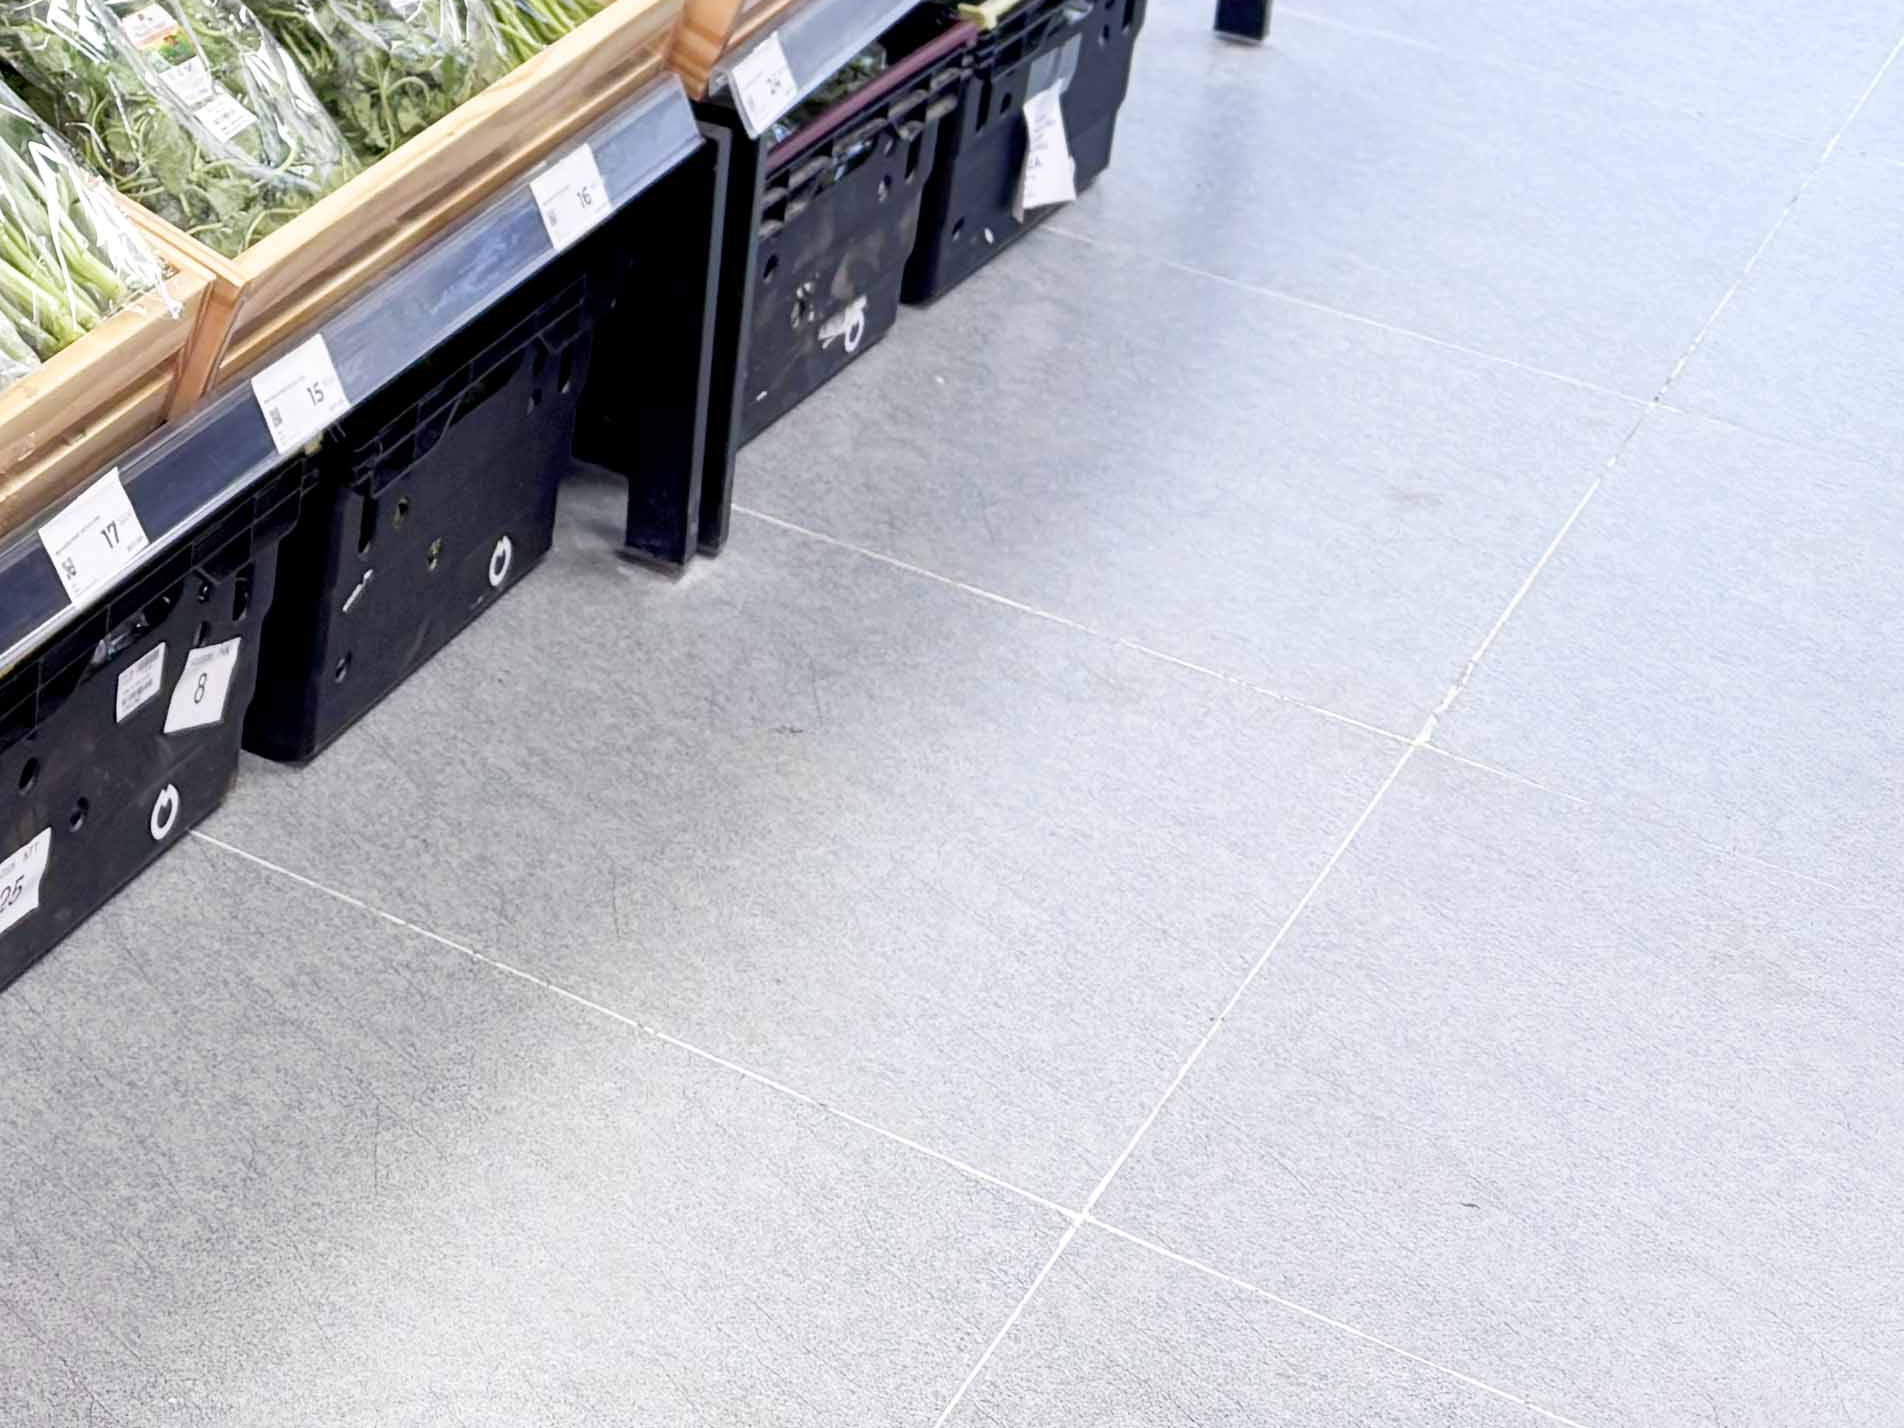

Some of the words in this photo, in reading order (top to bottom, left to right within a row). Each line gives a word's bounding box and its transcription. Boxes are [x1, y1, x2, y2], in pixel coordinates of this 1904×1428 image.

[305, 381, 325, 407] 15
[100, 520, 122, 550] 17
[192, 670, 208, 705] 8
